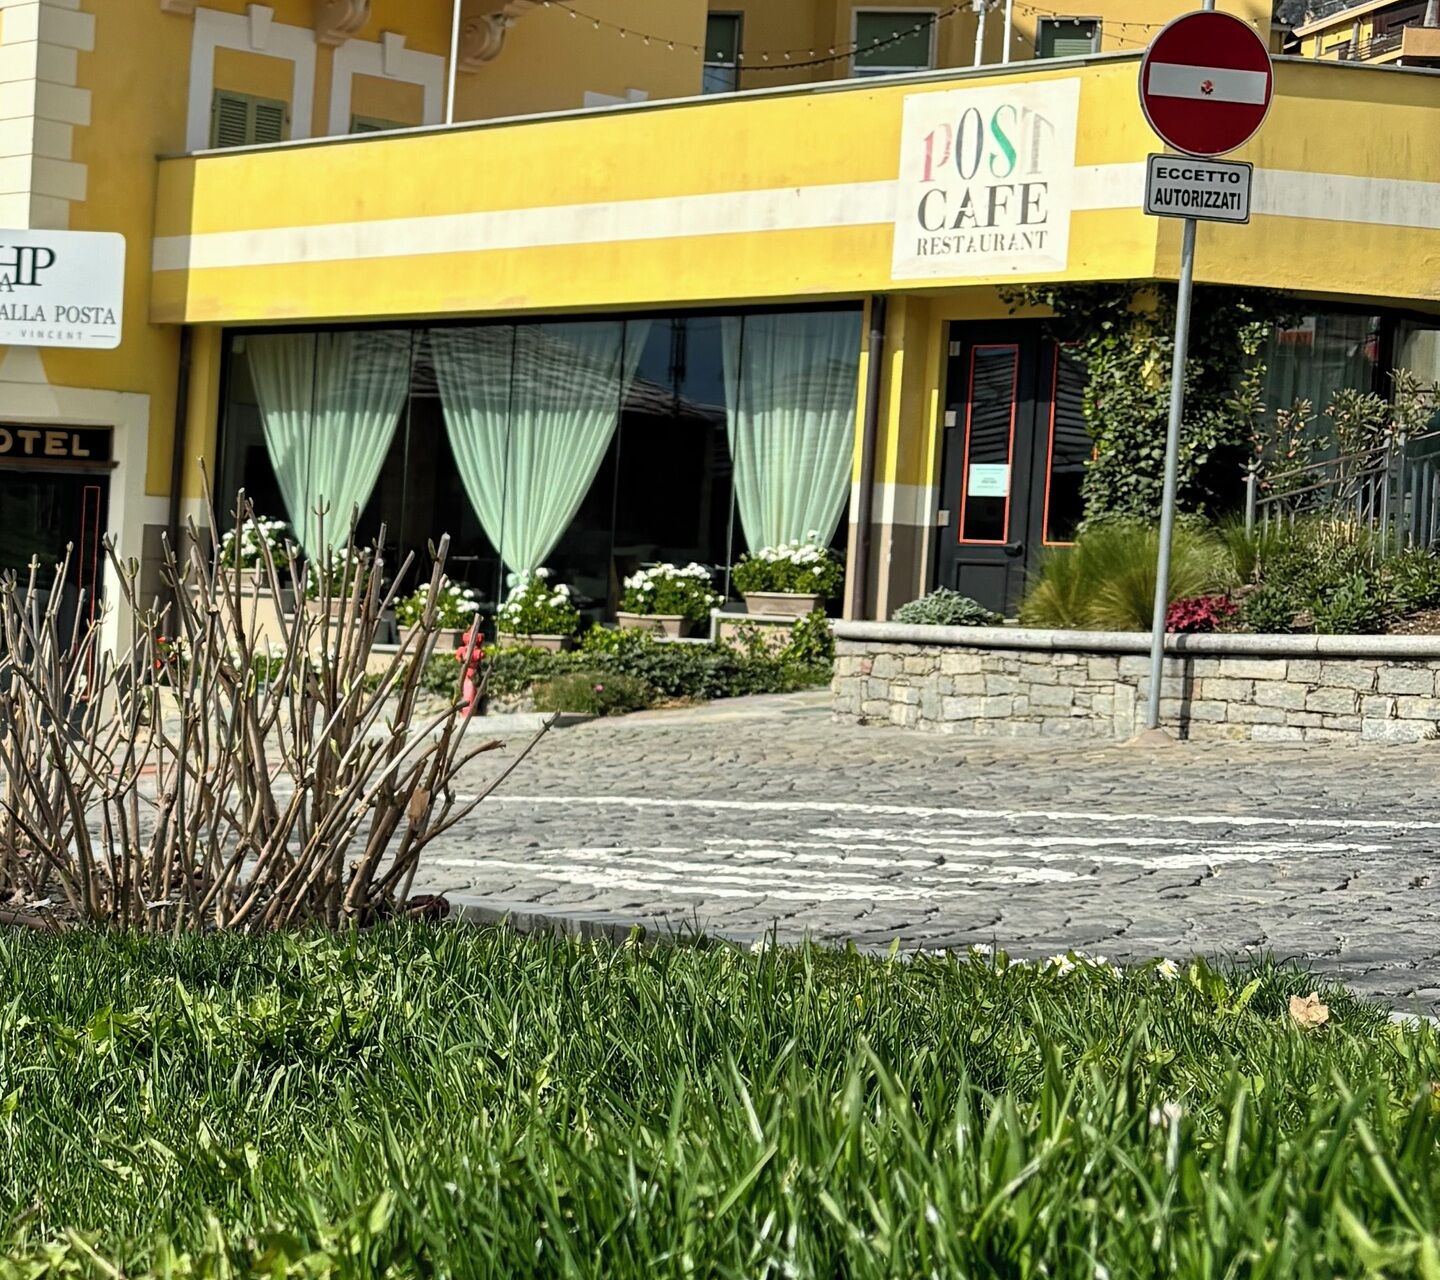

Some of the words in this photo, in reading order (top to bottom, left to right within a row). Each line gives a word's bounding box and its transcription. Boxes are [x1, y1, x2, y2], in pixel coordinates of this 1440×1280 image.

[919, 104, 1055, 183] POST
[1156, 167, 1241, 184] ECCETTO
[917, 182, 1048, 232] CAFE
[1154, 188, 1241, 210] AUTORIZZATI
[916, 231, 1048, 256] RESTAURANT
[55, 305, 117, 325] POSTA
[21, 329, 84, 341] VINCENT
